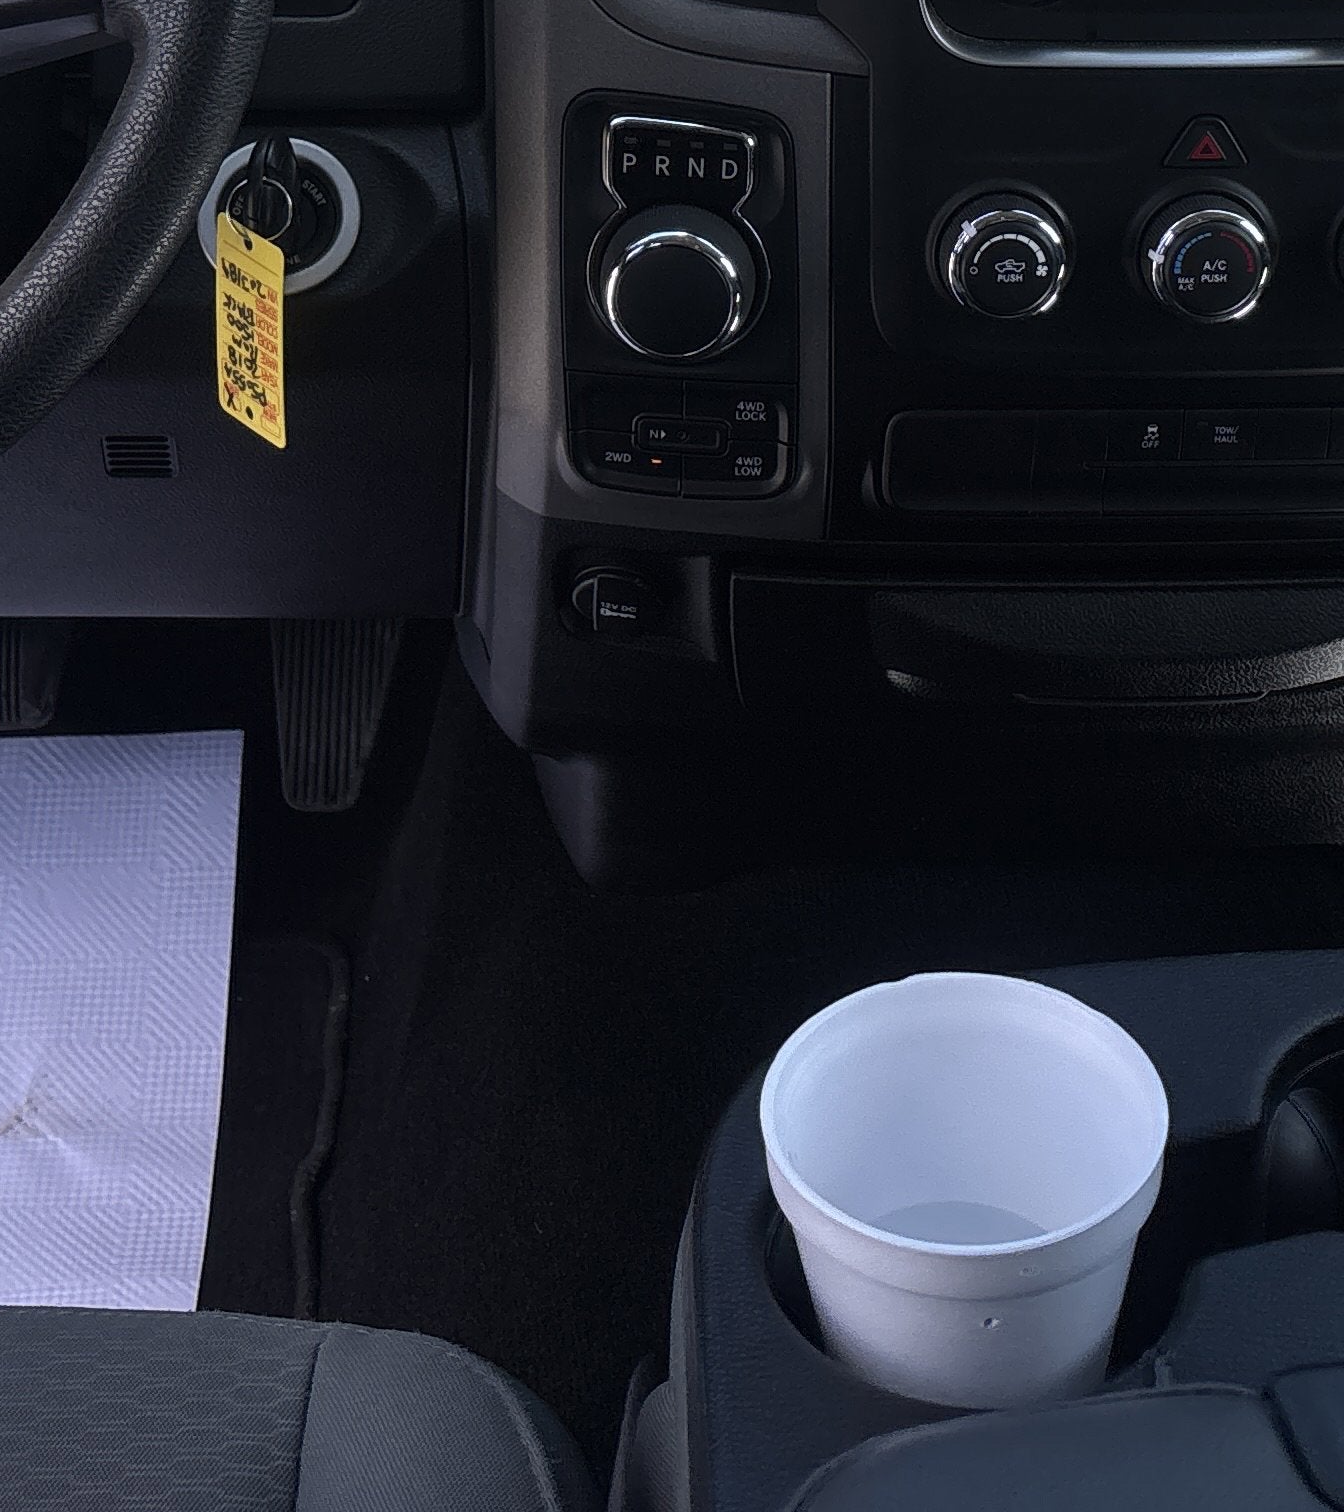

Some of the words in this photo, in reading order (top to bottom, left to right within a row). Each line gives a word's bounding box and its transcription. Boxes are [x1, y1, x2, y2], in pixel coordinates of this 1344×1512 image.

[622, 153, 637, 174] P
[656, 155, 670, 177] R
[688, 157, 705, 178] N
[721, 159, 738, 180] D
[302, 179, 327, 206] START
[233, 194, 246, 215] OFF
[1202, 258, 1228, 271] A/C
[997, 273, 1023, 283] PUSH
[1200, 273, 1228, 283] PUSH
[737, 401, 765, 411] 4WD
[735, 411, 766, 421] LOCK
[649, 429, 659, 439] N
[1214, 435, 1238, 443] HAUL
[1141, 440, 1160, 449] OFF
[605, 451, 632, 463] 2WD
[736, 456, 763, 466] 4WD
[734, 466, 762, 476] LOW
